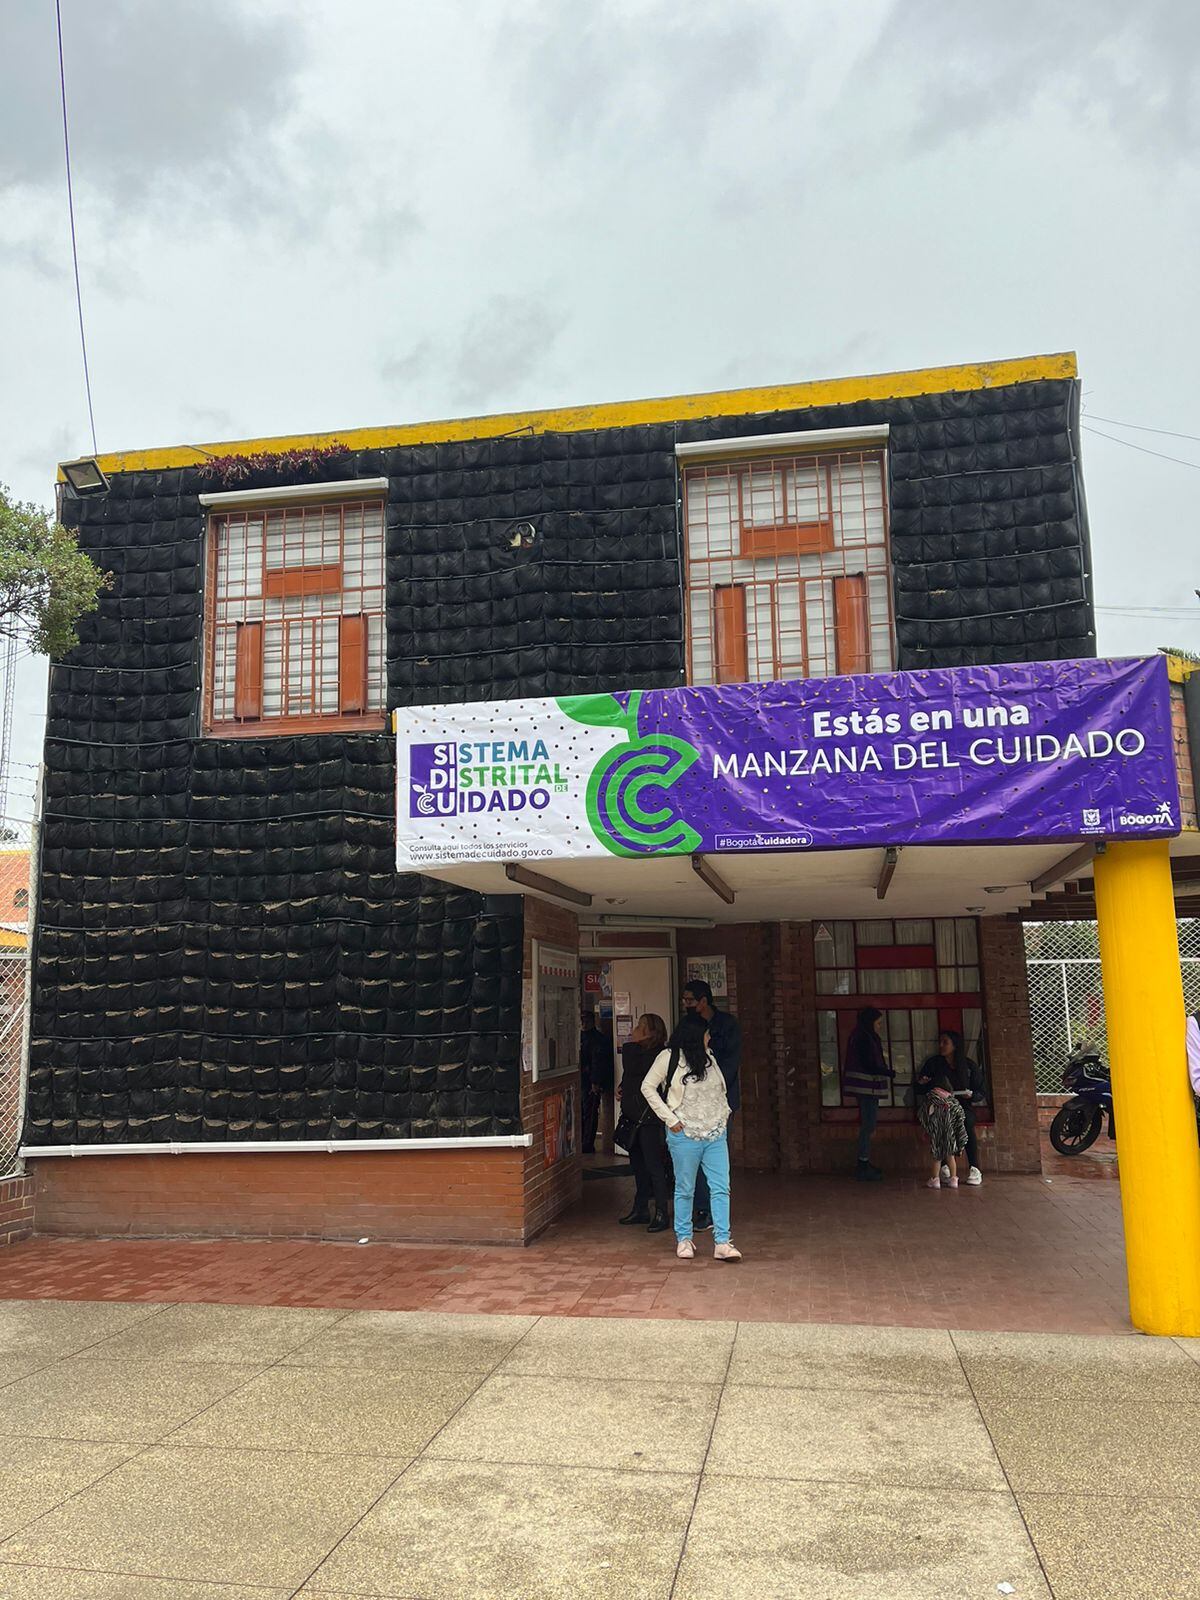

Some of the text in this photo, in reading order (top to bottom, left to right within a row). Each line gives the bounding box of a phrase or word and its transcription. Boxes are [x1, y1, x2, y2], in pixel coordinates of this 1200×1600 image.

[813, 704, 1030, 737] Estás en una
[434, 739, 549, 765] SISTEMA
[713, 728, 1145, 779] MANZANA DEL CUIDADO
[430, 763, 568, 790] DISTRITAL
[416, 788, 550, 814] CUIDADO
[409, 844, 441, 852] Consulta
[461, 842, 482, 850] todos
[496, 841, 528, 849] servicios
[409, 849, 553, 860] www.sistemadecuidado.gov.co
